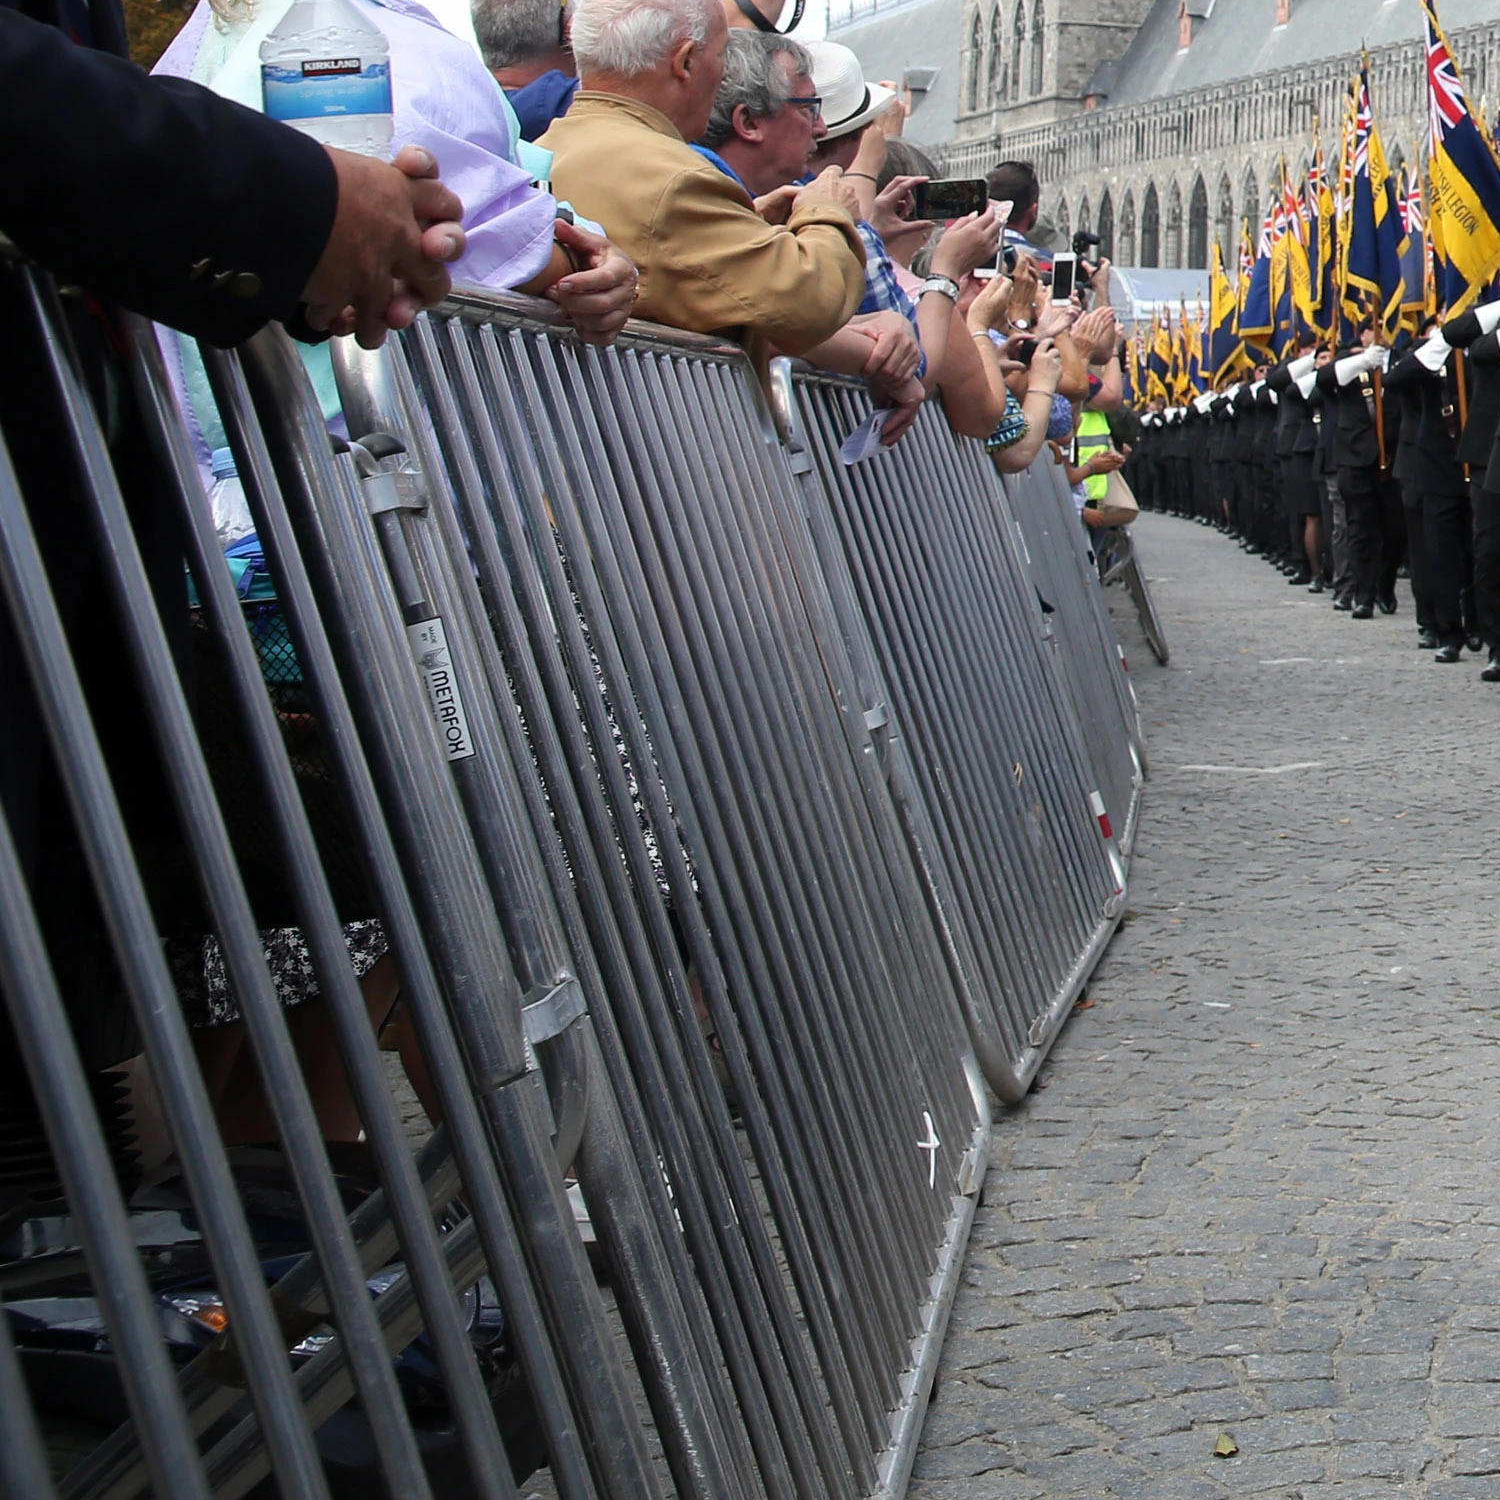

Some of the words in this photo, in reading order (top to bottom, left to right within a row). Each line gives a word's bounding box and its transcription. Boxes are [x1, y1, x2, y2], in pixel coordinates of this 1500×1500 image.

[304, 60, 360, 71] KIRKLAND
[1446, 191, 1480, 237] LEGION
[431, 670, 467, 754] METAFOX
